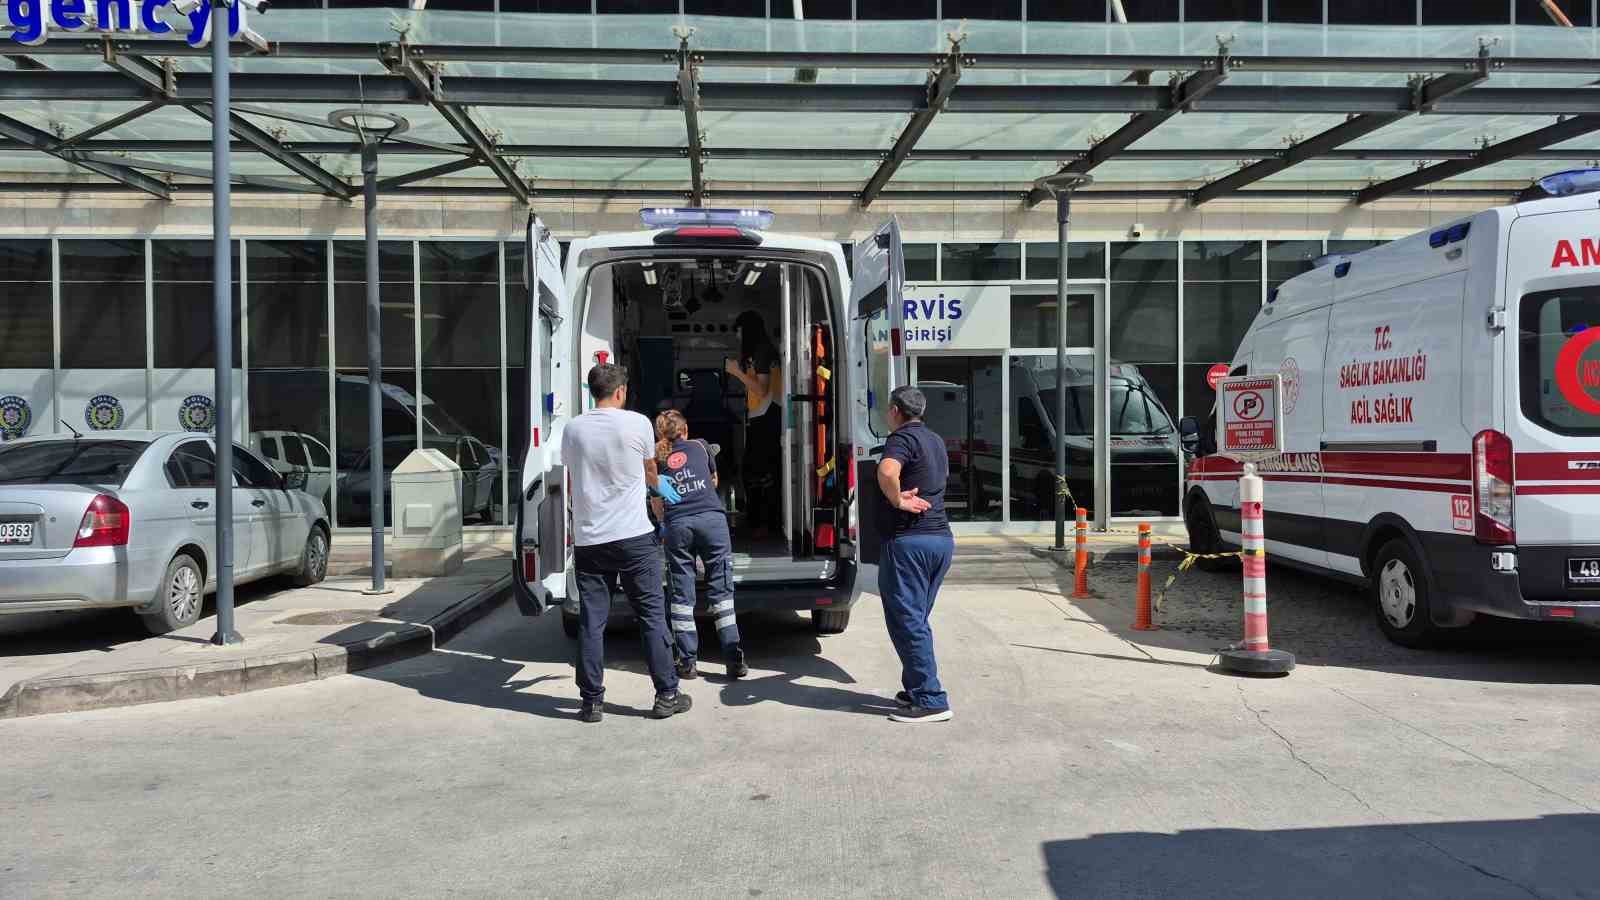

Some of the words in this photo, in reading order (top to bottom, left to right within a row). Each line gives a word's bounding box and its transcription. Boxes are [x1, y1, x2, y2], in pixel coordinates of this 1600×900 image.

[905, 326, 952, 342] GİRİŞİ
[1374, 325, 1392, 351] T.C.
[1340, 360, 1371, 388] SAĞLIK
[1373, 349, 1427, 385] BAKANLIĞI
[1351, 395, 1372, 424] ACİL
[1374, 393, 1413, 423] SAĞLIK
[1454, 499, 1470, 517] 112
